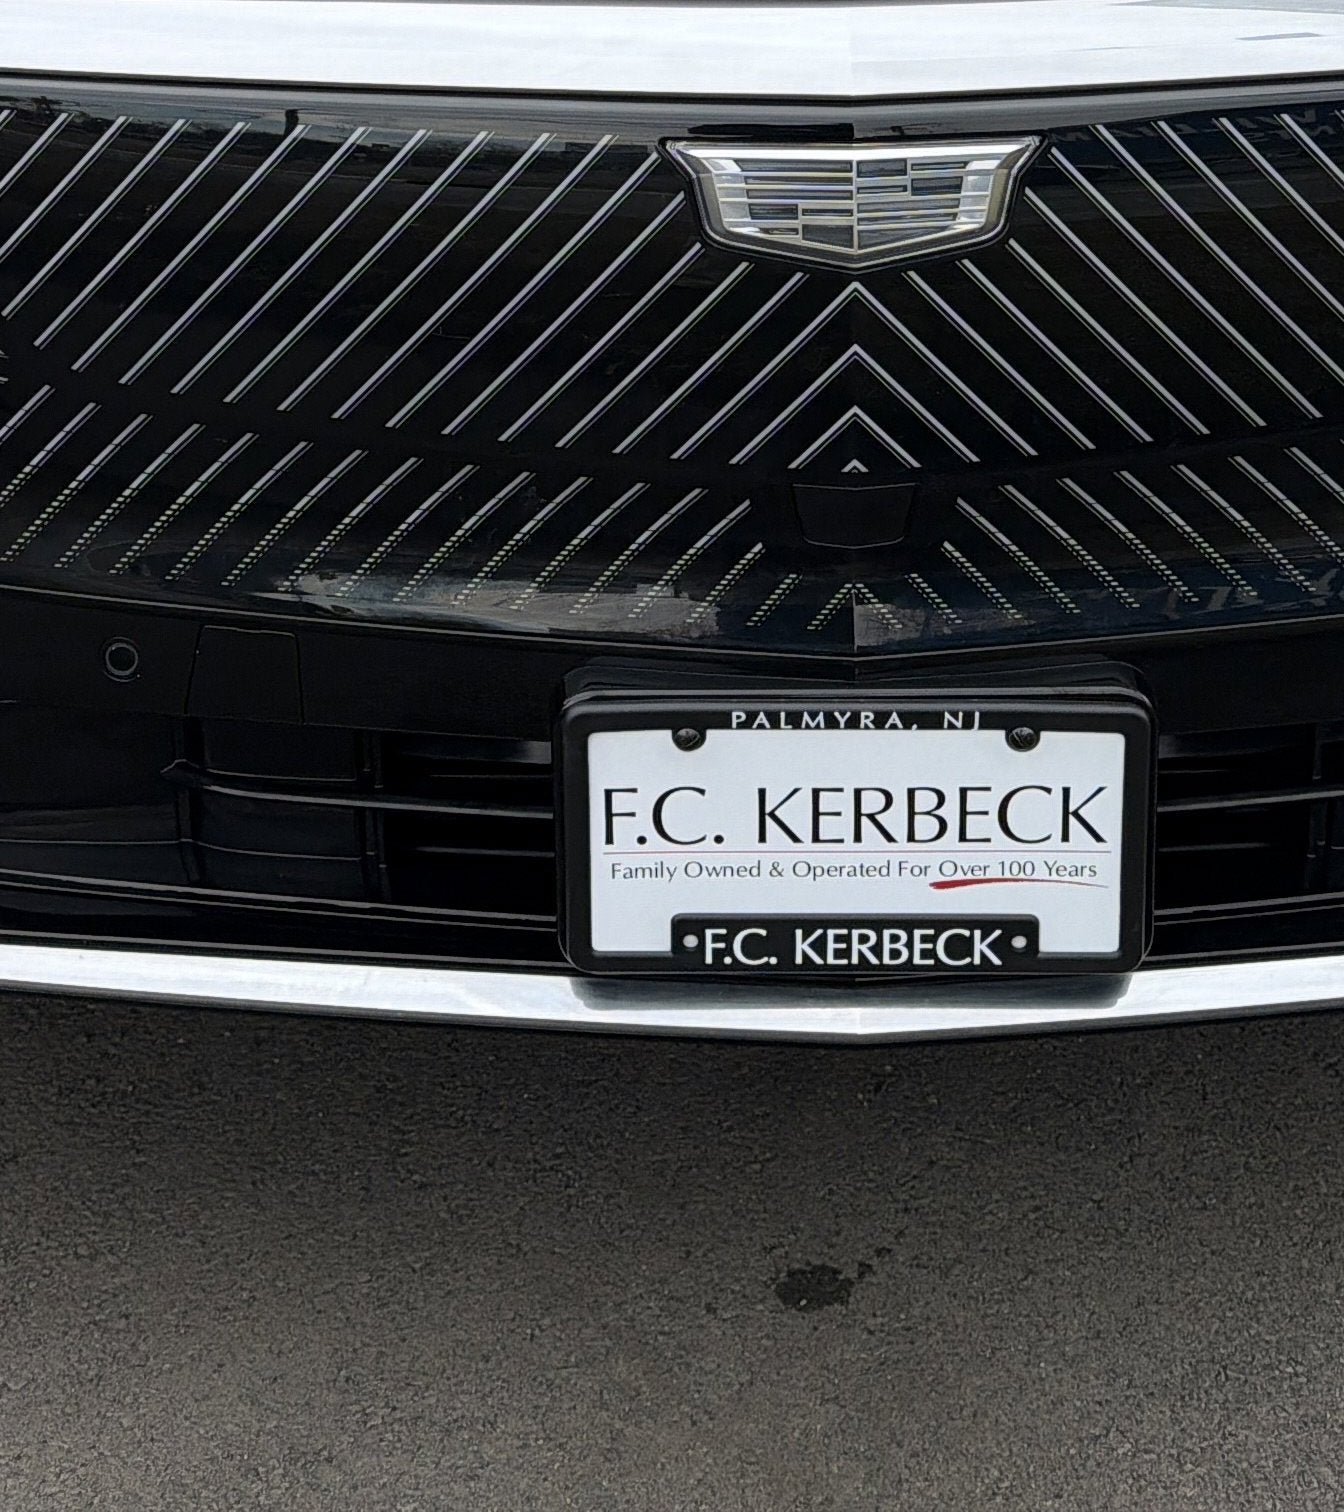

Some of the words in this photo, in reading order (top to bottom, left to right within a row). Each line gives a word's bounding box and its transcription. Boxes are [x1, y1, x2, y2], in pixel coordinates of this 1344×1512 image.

[731, 710, 919, 732] PALMYRA,
[944, 710, 982, 731] NJ
[603, 786, 726, 846] F.C.
[758, 785, 1108, 845] KERBECK
[611, 860, 678, 882] Family
[684, 859, 761, 879] Owned
[769, 861, 785, 879] &
[792, 859, 891, 881] Operated
[898, 861, 932, 879] For
[939, 861, 990, 879] Over
[998, 860, 1036, 879] 100
[1044, 860, 1098, 879] Years
[704, 928, 778, 966] F.C.
[794, 928, 1004, 966] KERBECK
